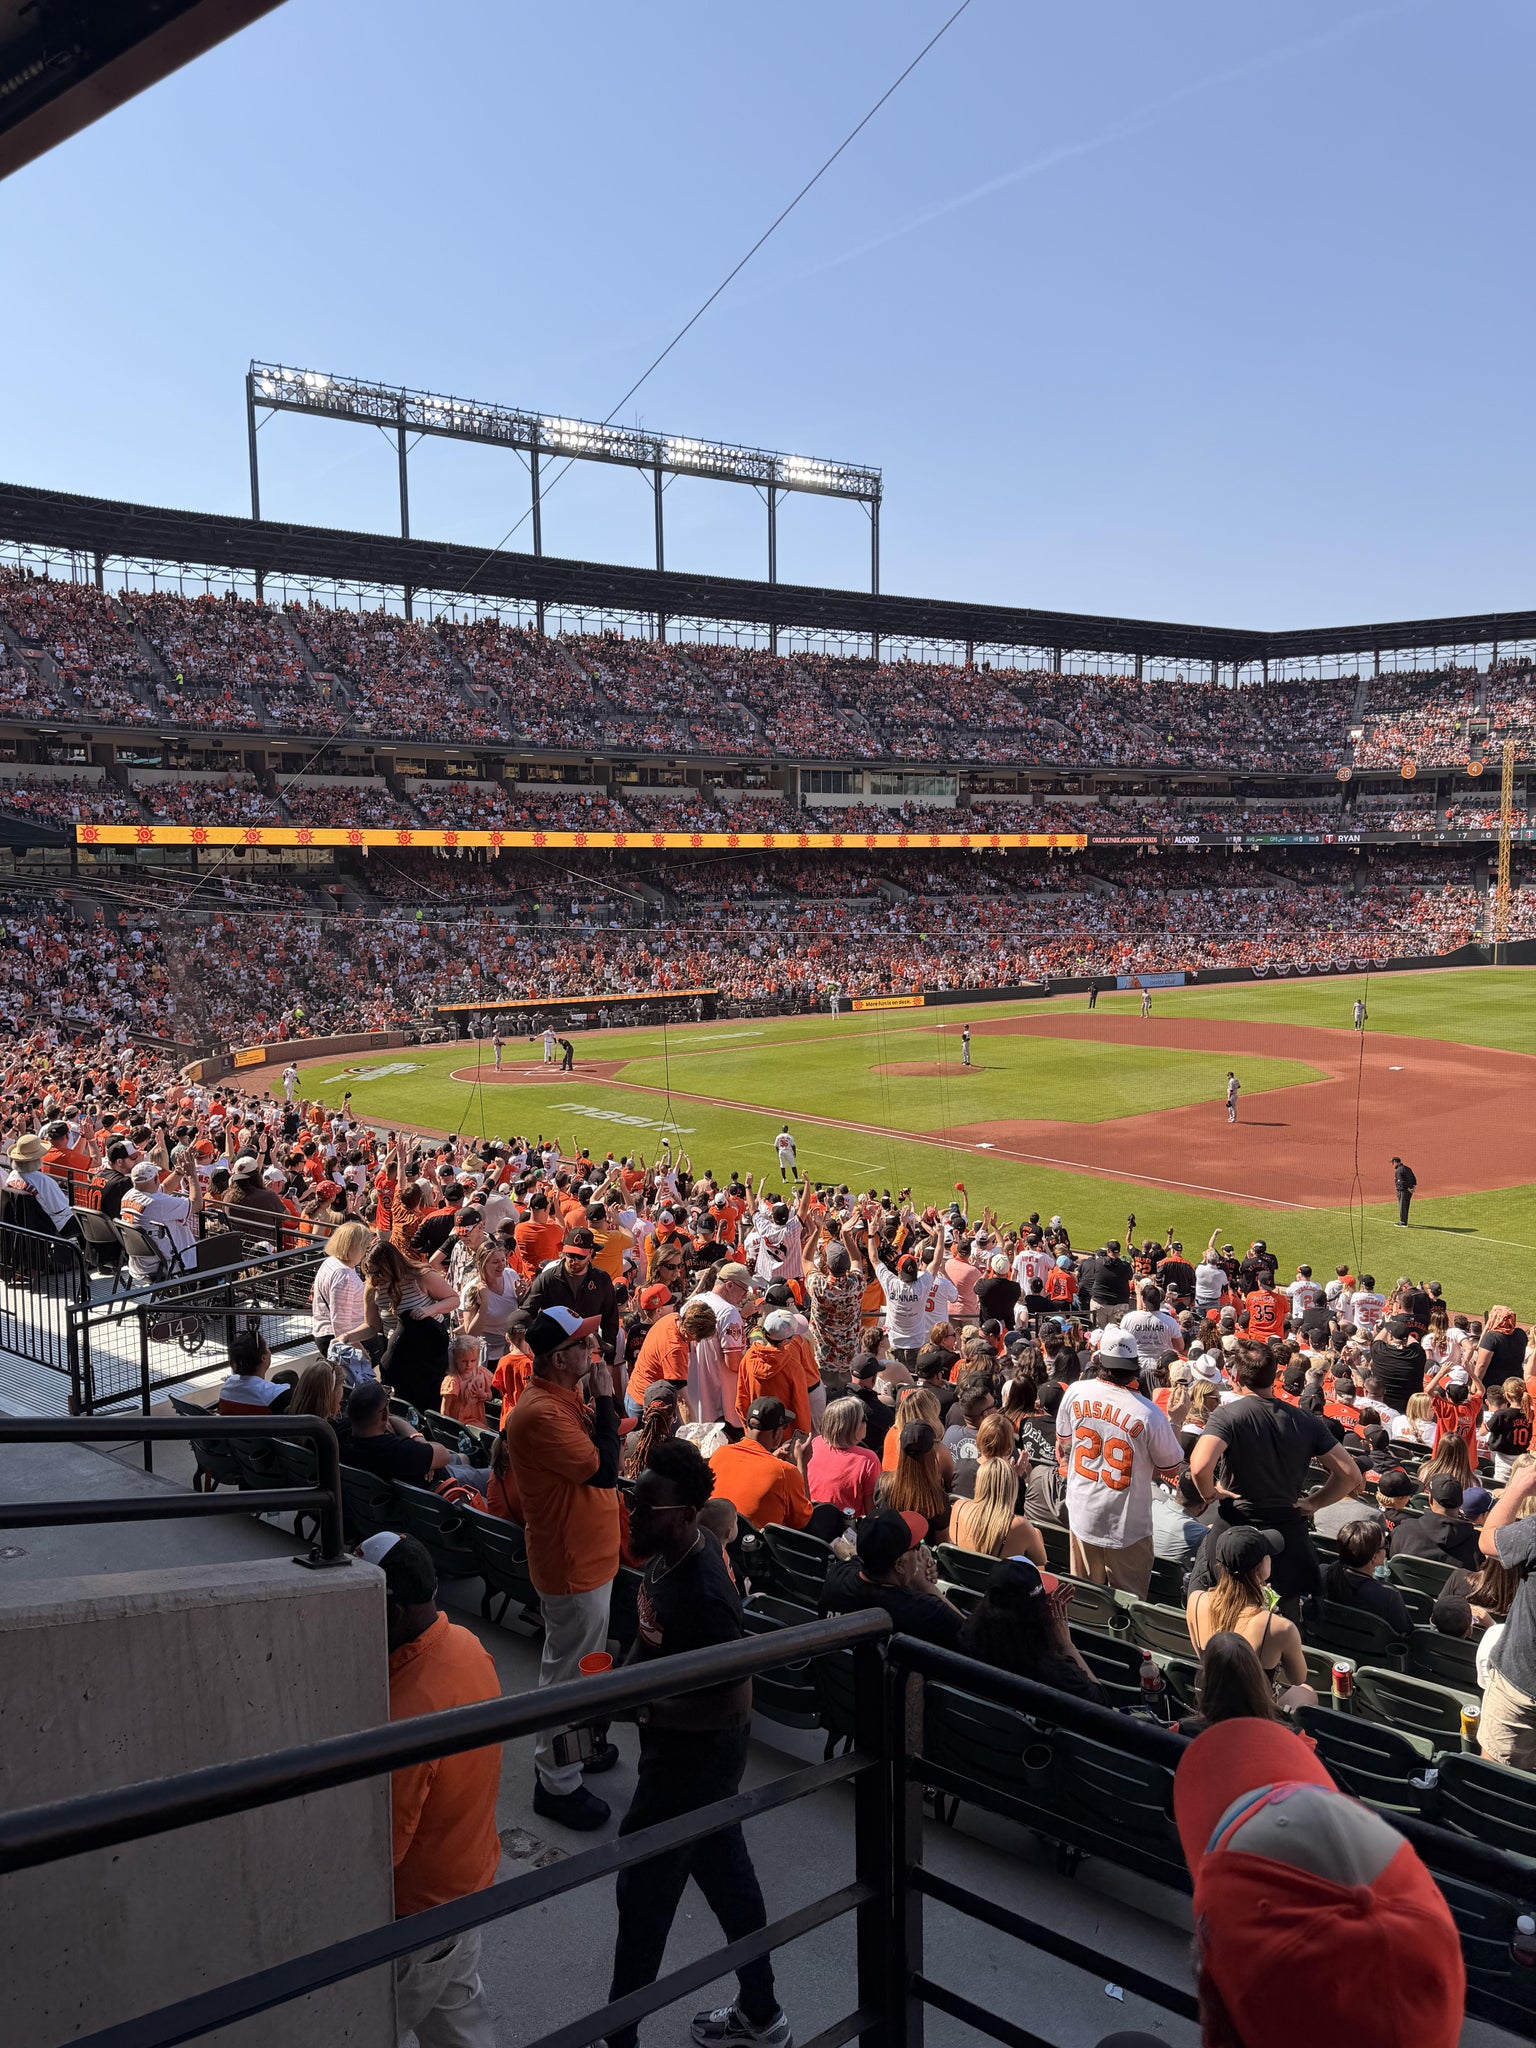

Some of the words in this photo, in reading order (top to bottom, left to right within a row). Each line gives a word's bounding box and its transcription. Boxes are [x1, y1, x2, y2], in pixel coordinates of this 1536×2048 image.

[1338, 771, 1350, 779] 20
[1406, 767, 1412, 776] 5
[1472, 765, 1479, 773] 4
[1174, 835, 1200, 844] ALONSO
[1338, 834, 1360, 842] RYAN
[382, 1196, 392, 1210] 2
[1025, 1264, 1035, 1278] 8
[1303, 1295, 1313, 1310] 2
[1252, 1304, 1275, 1322] 35
[1359, 1308, 1380, 1323] 35
[168, 1320, 185, 1337] 14
[1135, 1324, 1165, 1332] GUNNAR
[1072, 1400, 1145, 1439] BASALLO
[1513, 1428, 1529, 1446] 10
[1074, 1425, 1134, 1491] 29
